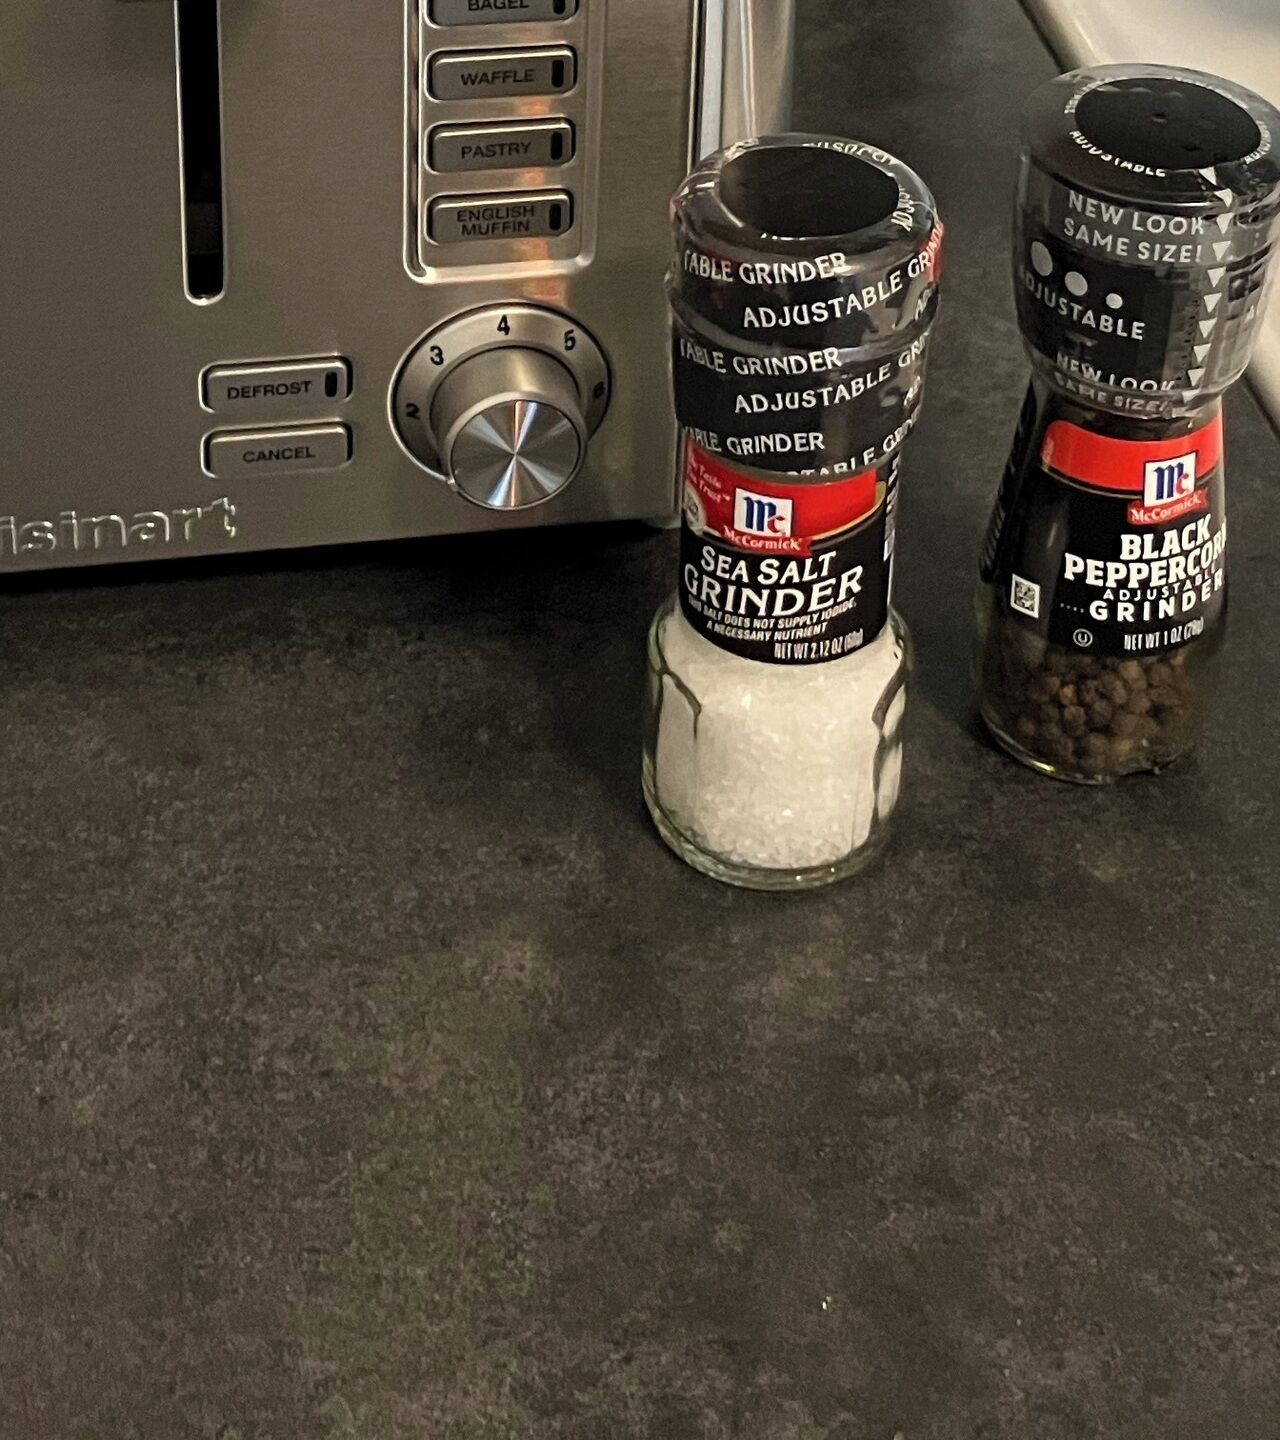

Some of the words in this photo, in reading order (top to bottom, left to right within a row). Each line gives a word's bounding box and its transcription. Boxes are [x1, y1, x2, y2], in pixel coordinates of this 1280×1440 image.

[460, 69, 536, 86] WAFFLE
[461, 142, 533, 159] PASTRY
[456, 204, 536, 223] ENGLISH
[1069, 190, 1124, 226] NEW
[1132, 212, 1205, 236] LOOK
[461, 220, 531, 237] MUFFIN
[1064, 218, 1129, 257] SAME
[1137, 240, 1203, 264] SIZE!
[739, 252, 849, 285] GRINDER
[743, 270, 903, 328] ADJUSTABLE
[496, 314, 511, 335] 4
[563, 329, 576, 351] 5
[429, 346, 444, 366] 3
[733, 347, 842, 377] GRINDER
[1056, 351, 1102, 382] NEW
[227, 380, 312, 400] DEFROST
[735, 362, 891, 414] ADJUSTABLE
[405, 402, 420, 419] 2
[242, 446, 317, 464] CANCEL
[726, 432, 825, 456] GRINDER
[1130, 492, 1202, 523] McCormick
[723, 524, 801, 552] McCormick
[1120, 513, 1212, 561] BLACK
[700, 545, 750, 584] SEA
[757, 550, 837, 586] SALT
[684, 565, 864, 617] GRINDER
[1089, 568, 1223, 622] GRINDER
[706, 620, 713, 630] A
[714, 623, 770, 642] NECESSARY
[773, 621, 829, 642] NUTRIENT
[724, 614, 750, 629] DOES
[753, 617, 774, 630] NOT
[777, 613, 817, 630] SUPPLY
[774, 642, 792, 659] NET
[793, 641, 809, 659] WT
[810, 639, 830, 659] 2.12
[831, 635, 844, 655] OZ
[1124, 634, 1143, 651] NET
[1145, 632, 1160, 649] WT
[1171, 625, 1183, 643] OZ
